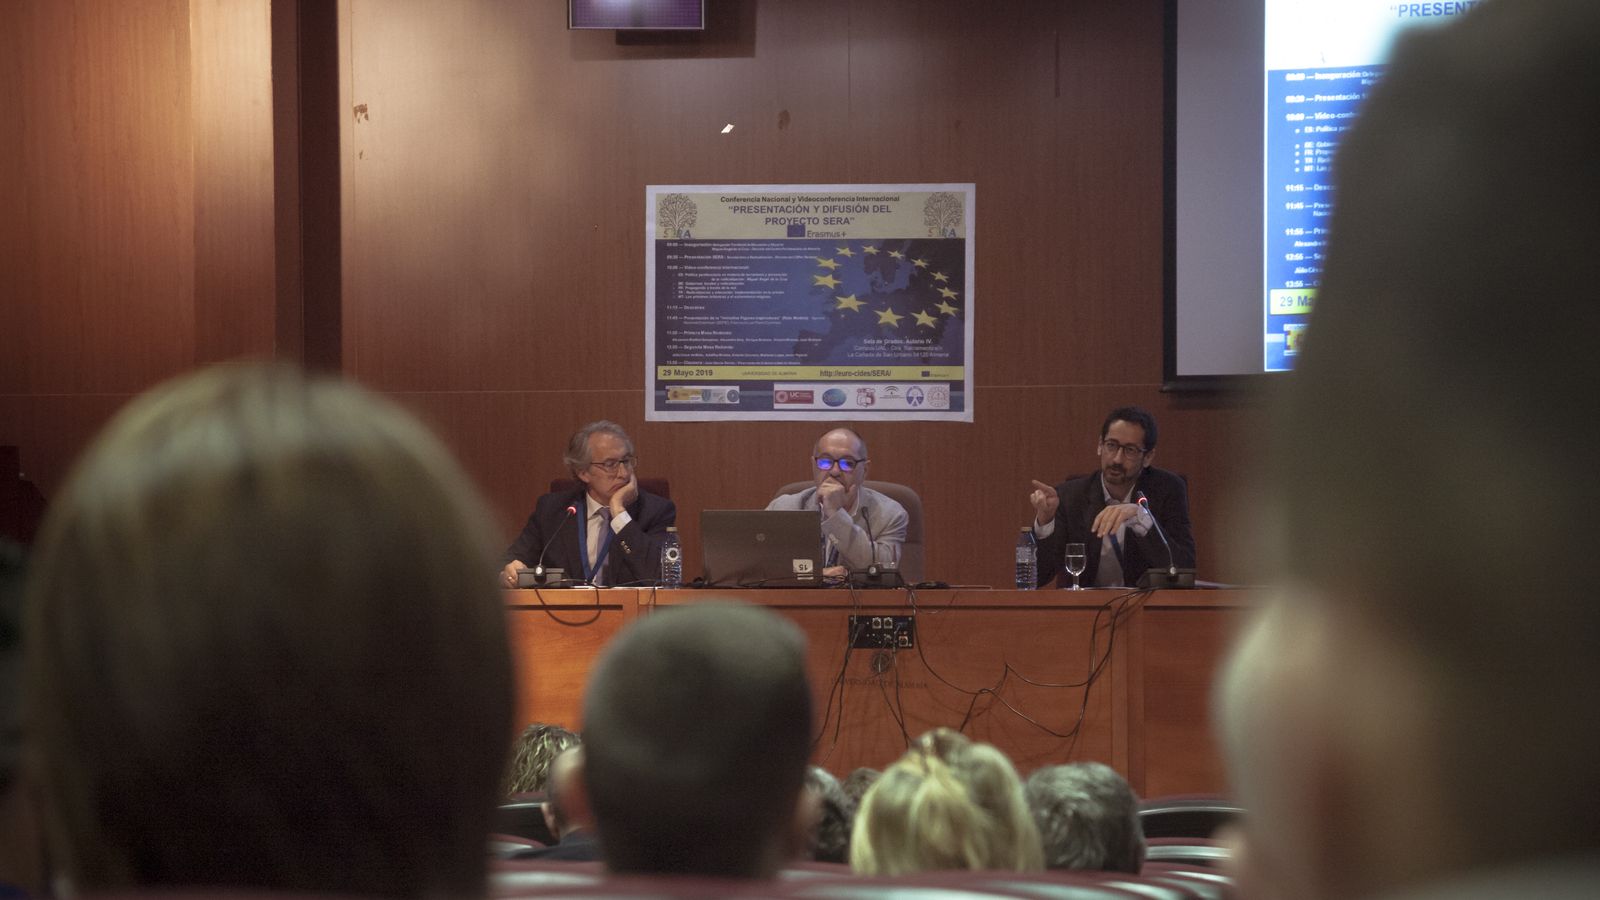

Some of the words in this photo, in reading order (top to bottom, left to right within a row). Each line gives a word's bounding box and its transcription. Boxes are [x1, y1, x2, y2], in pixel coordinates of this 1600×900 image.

[720, 195, 761, 203] Conferencia
[762, 195, 791, 203] Nacional
[797, 195, 855, 203] Videoconferencia
[813, 205, 820, 214] Y
[822, 202, 870, 214] DIFUSIÓN
[872, 204, 892, 213] DEL
[765, 216, 820, 226] PROYECTO
[807, 230, 847, 238] Erasmus+
[1280, 296, 1293, 307] 29
[662, 369, 672, 377] 29
[673, 369, 695, 378] Mayo
[695, 369, 714, 377] 2019
